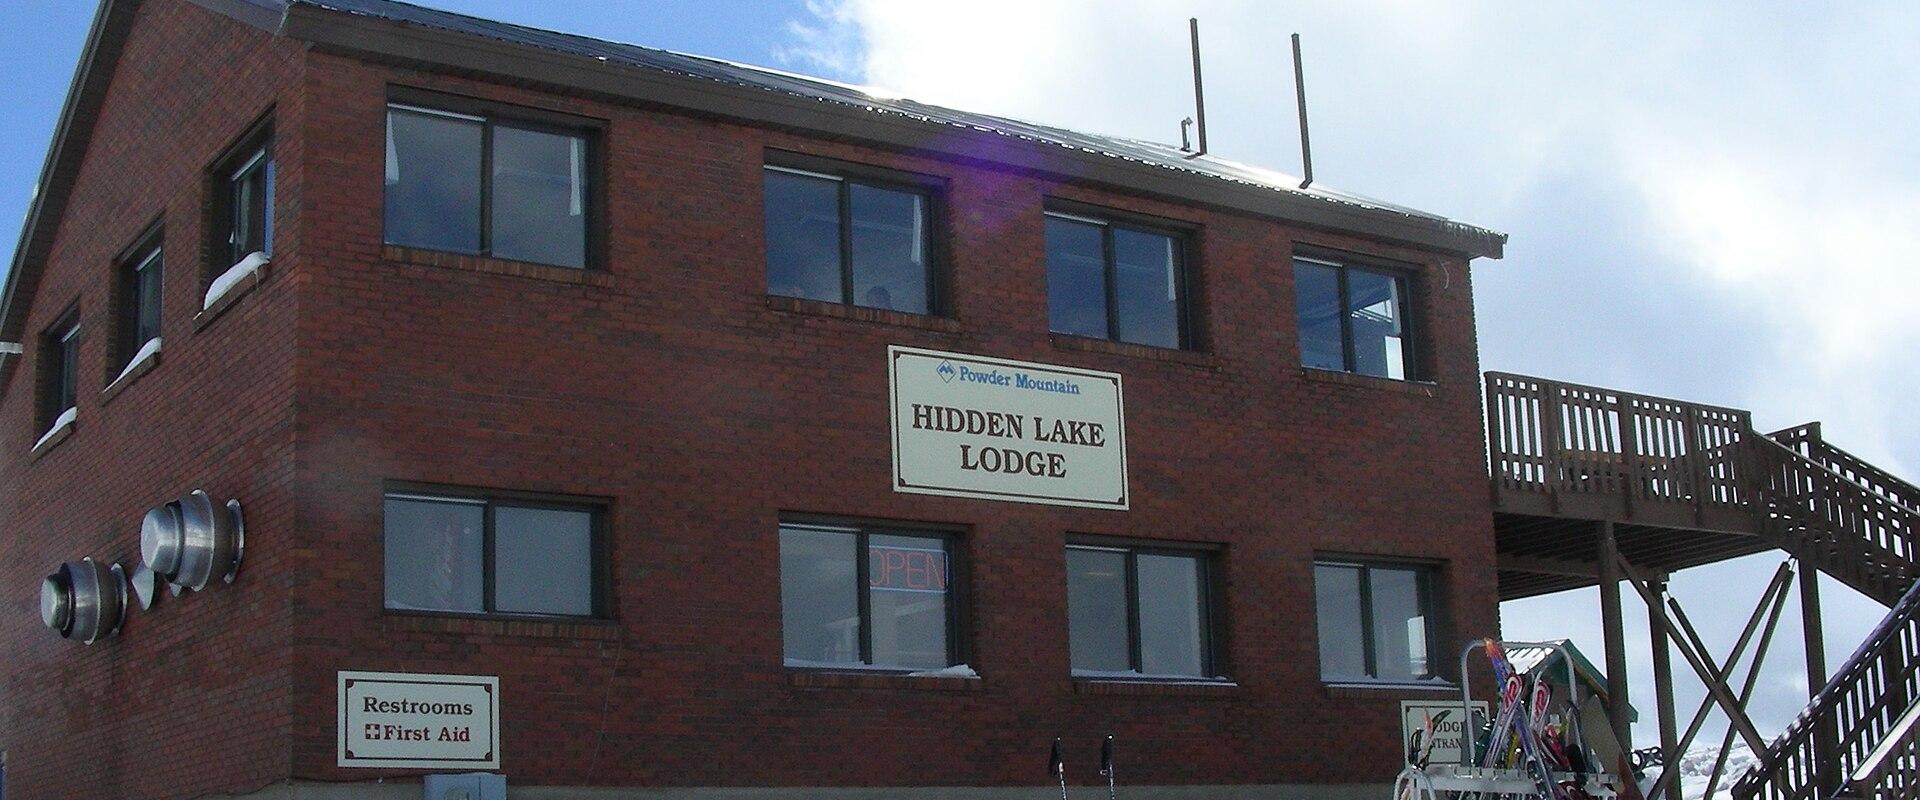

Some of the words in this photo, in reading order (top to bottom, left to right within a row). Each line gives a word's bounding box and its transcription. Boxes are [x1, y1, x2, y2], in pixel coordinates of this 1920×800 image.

[959, 366, 1011, 386] Powder
[1015, 373, 1081, 395] Mountain
[911, 403, 1023, 439] HIDDEN
[1034, 416, 1106, 448] LAKE
[960, 444, 1067, 478] LODGE
[869, 549, 945, 588] OPEN
[363, 697, 473, 715] Restrooms
[384, 725, 430, 741] First
[438, 726, 471, 742] Aid
